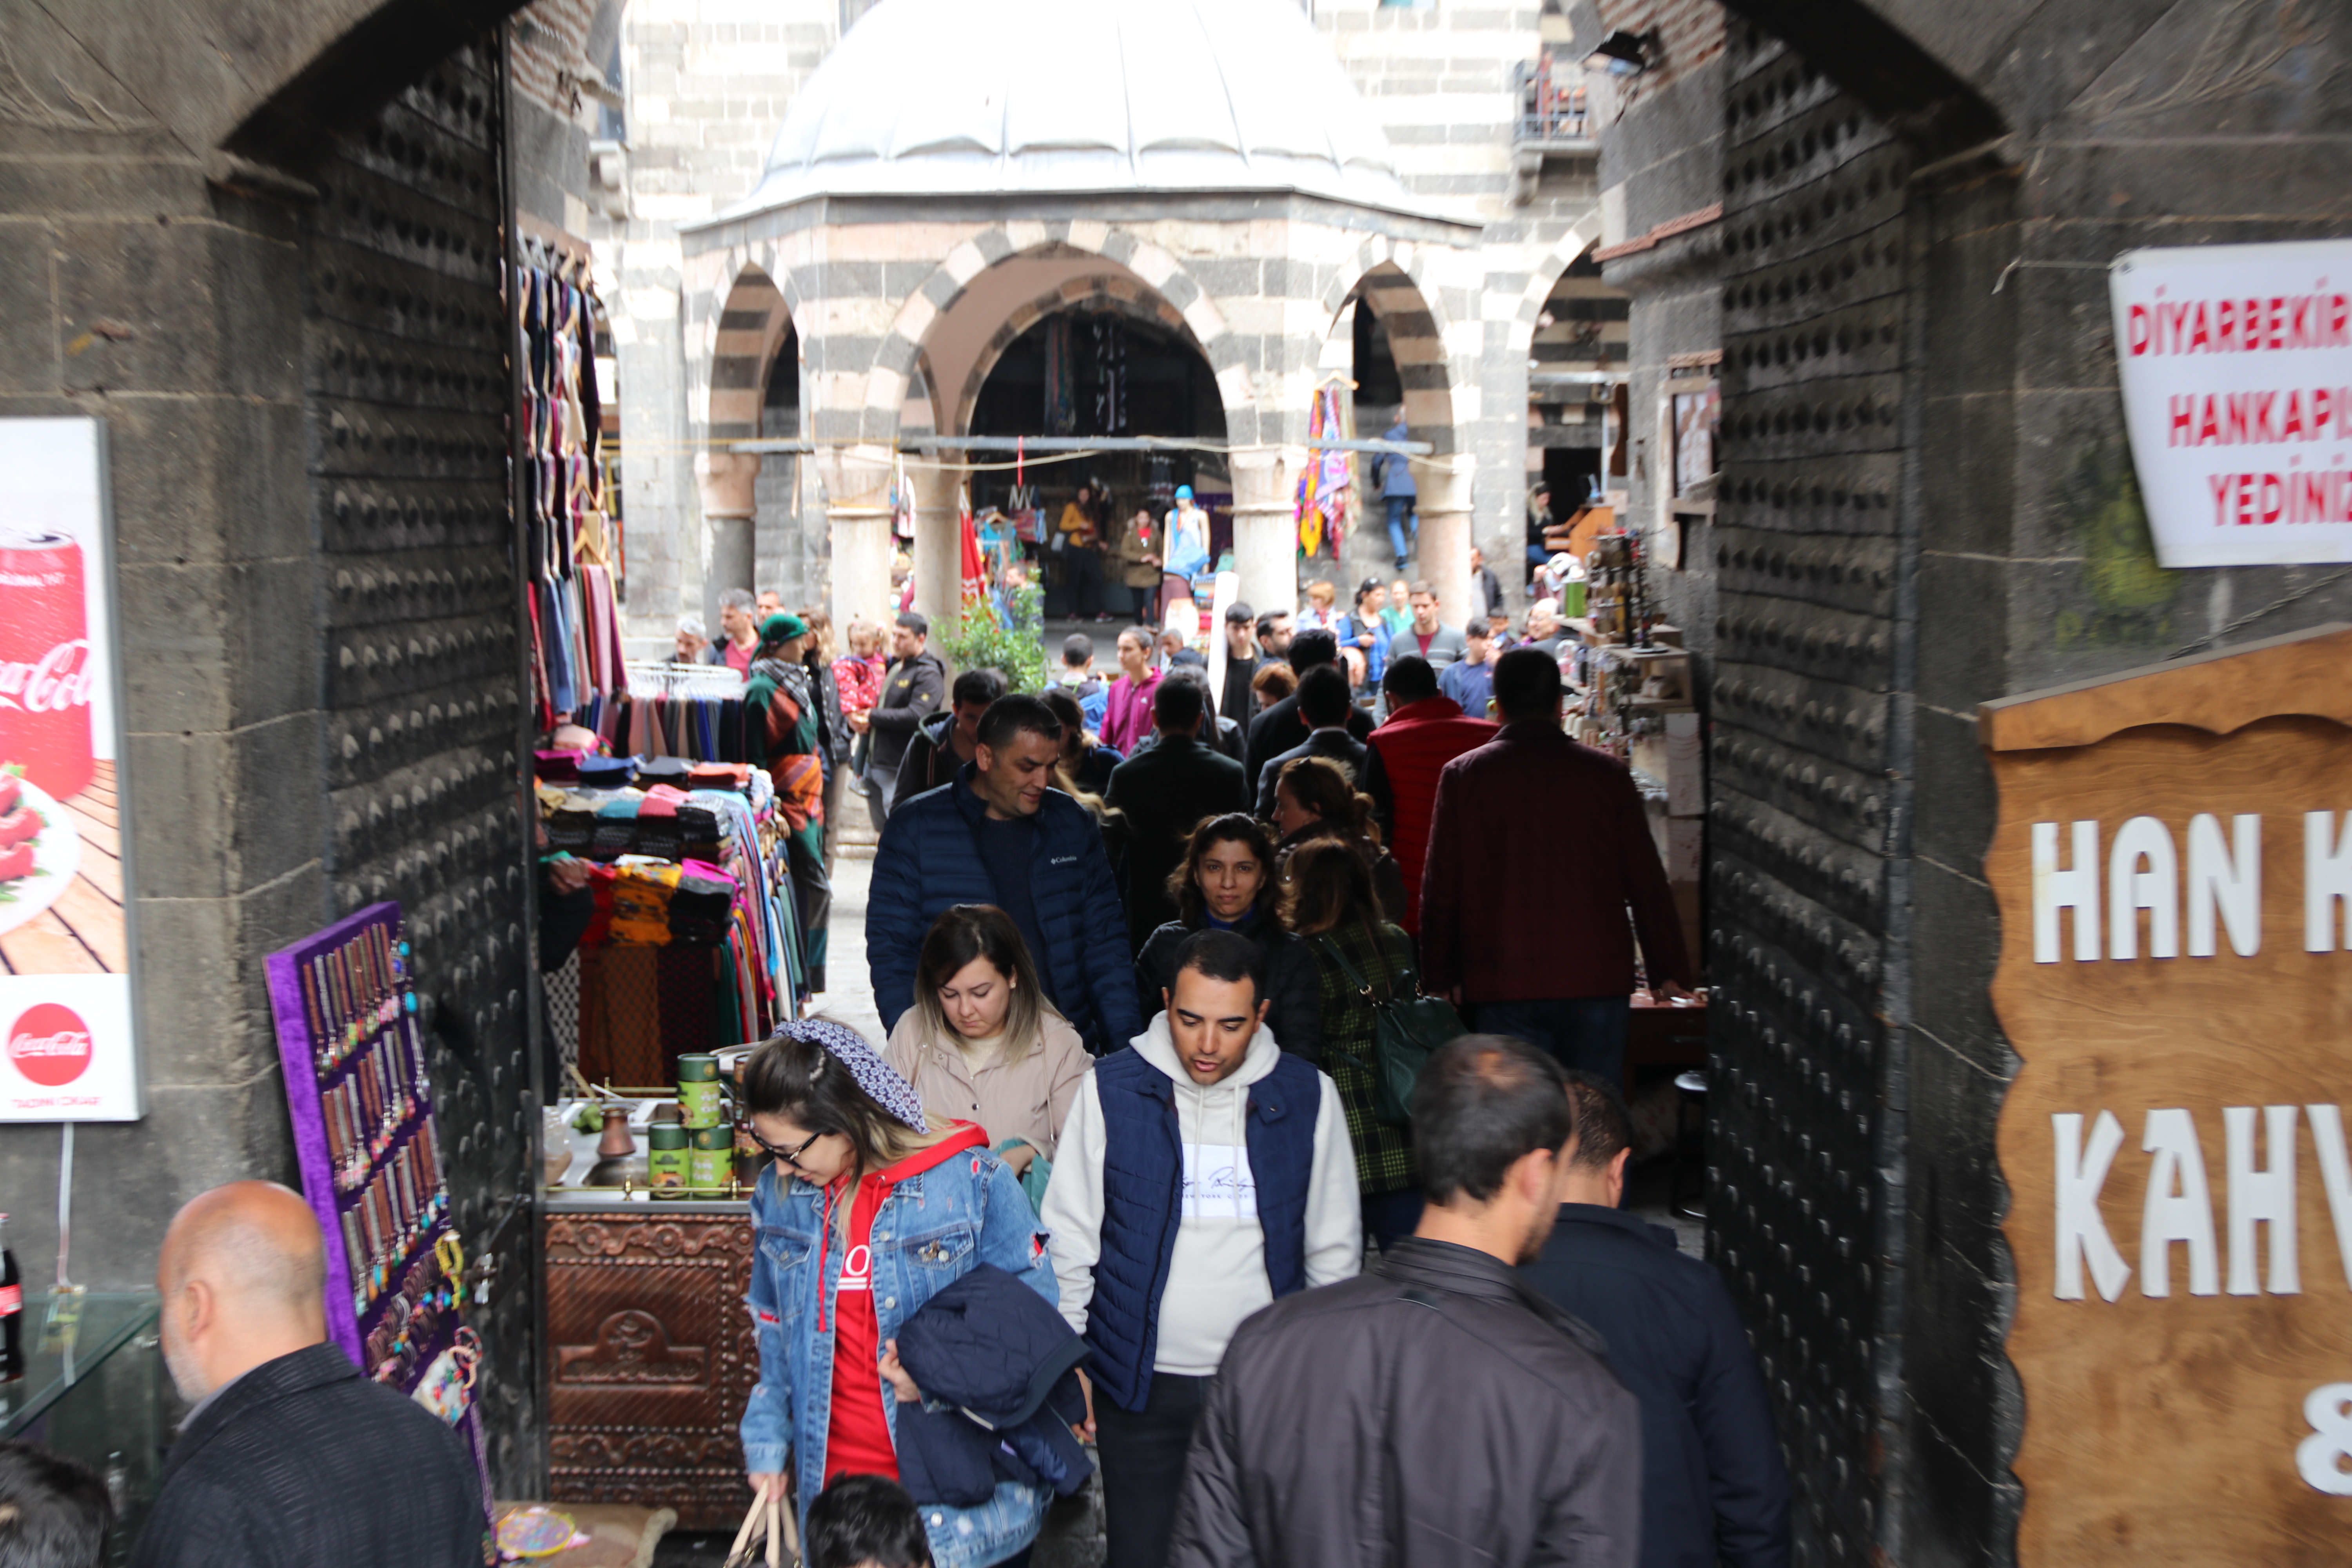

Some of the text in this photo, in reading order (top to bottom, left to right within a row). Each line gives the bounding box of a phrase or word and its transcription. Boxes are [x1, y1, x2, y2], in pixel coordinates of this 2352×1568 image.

[2167, 385, 2352, 449] HANKAPI
[2032, 813, 2262, 963] HAN
[9, 1031, 91, 1058] Coca-Cola
